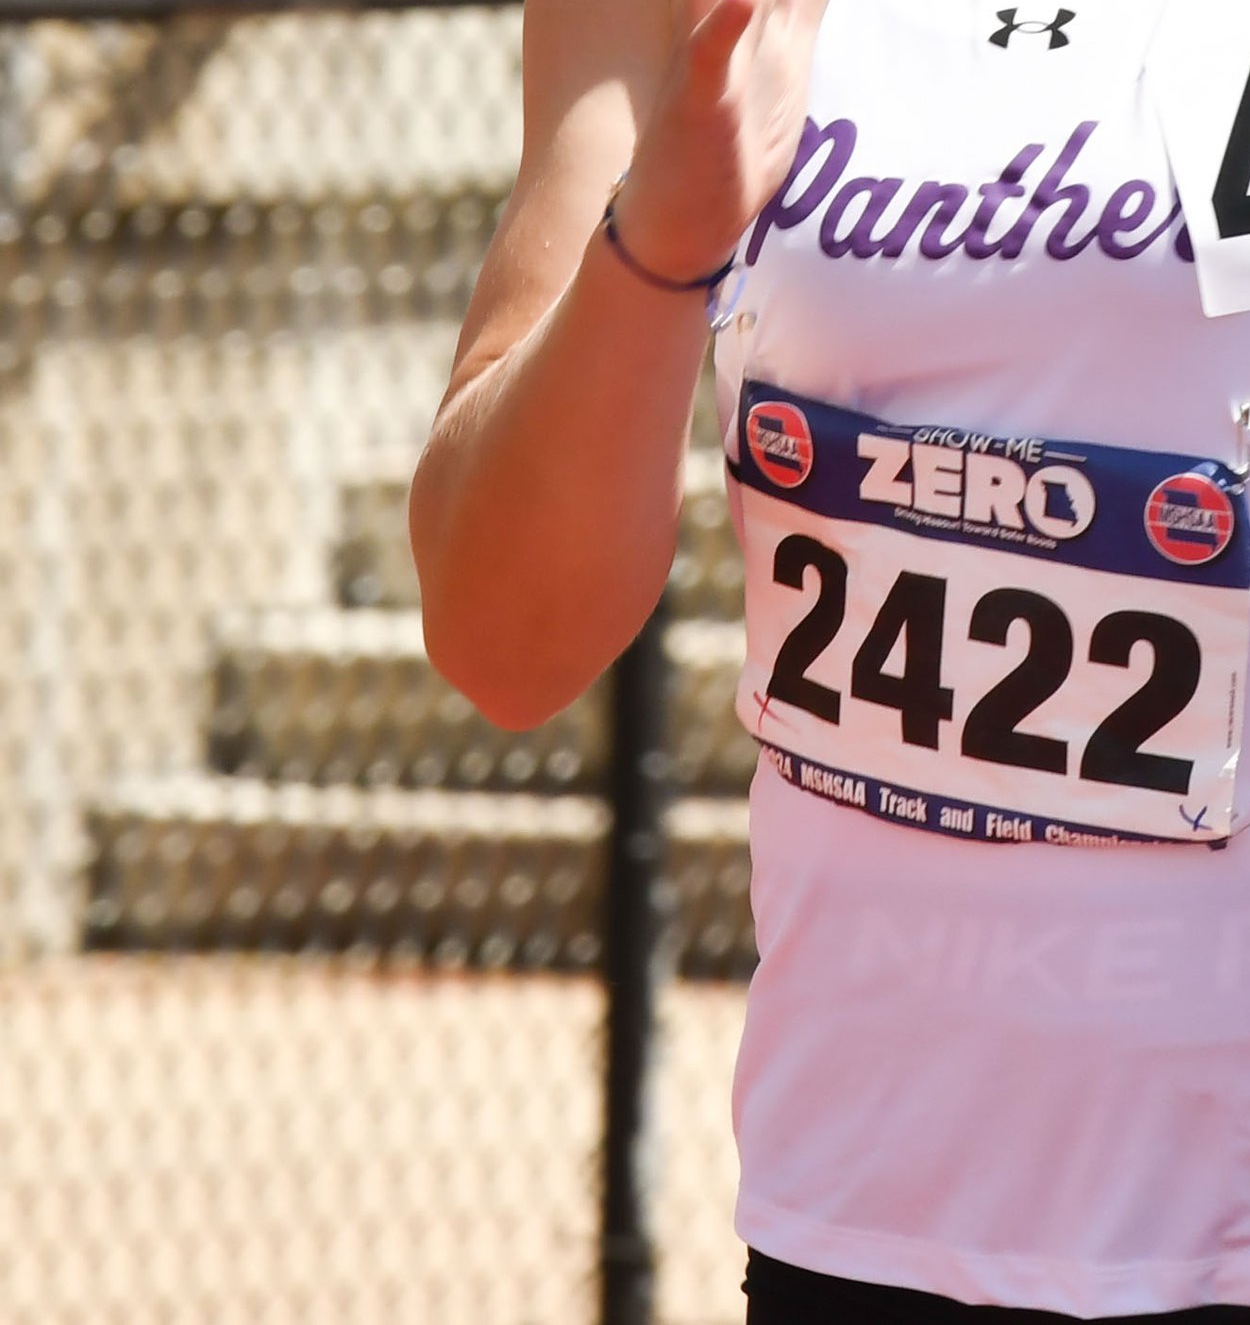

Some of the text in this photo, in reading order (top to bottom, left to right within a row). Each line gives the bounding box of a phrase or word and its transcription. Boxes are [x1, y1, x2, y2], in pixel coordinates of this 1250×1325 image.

[857, 433, 1096, 540] ZERO
[766, 533, 1201, 795] 2422
[800, 762, 867, 807] MSHSAA
[879, 787, 928, 823] Track
[939, 805, 974, 833] and
[985, 812, 1033, 842] Field
